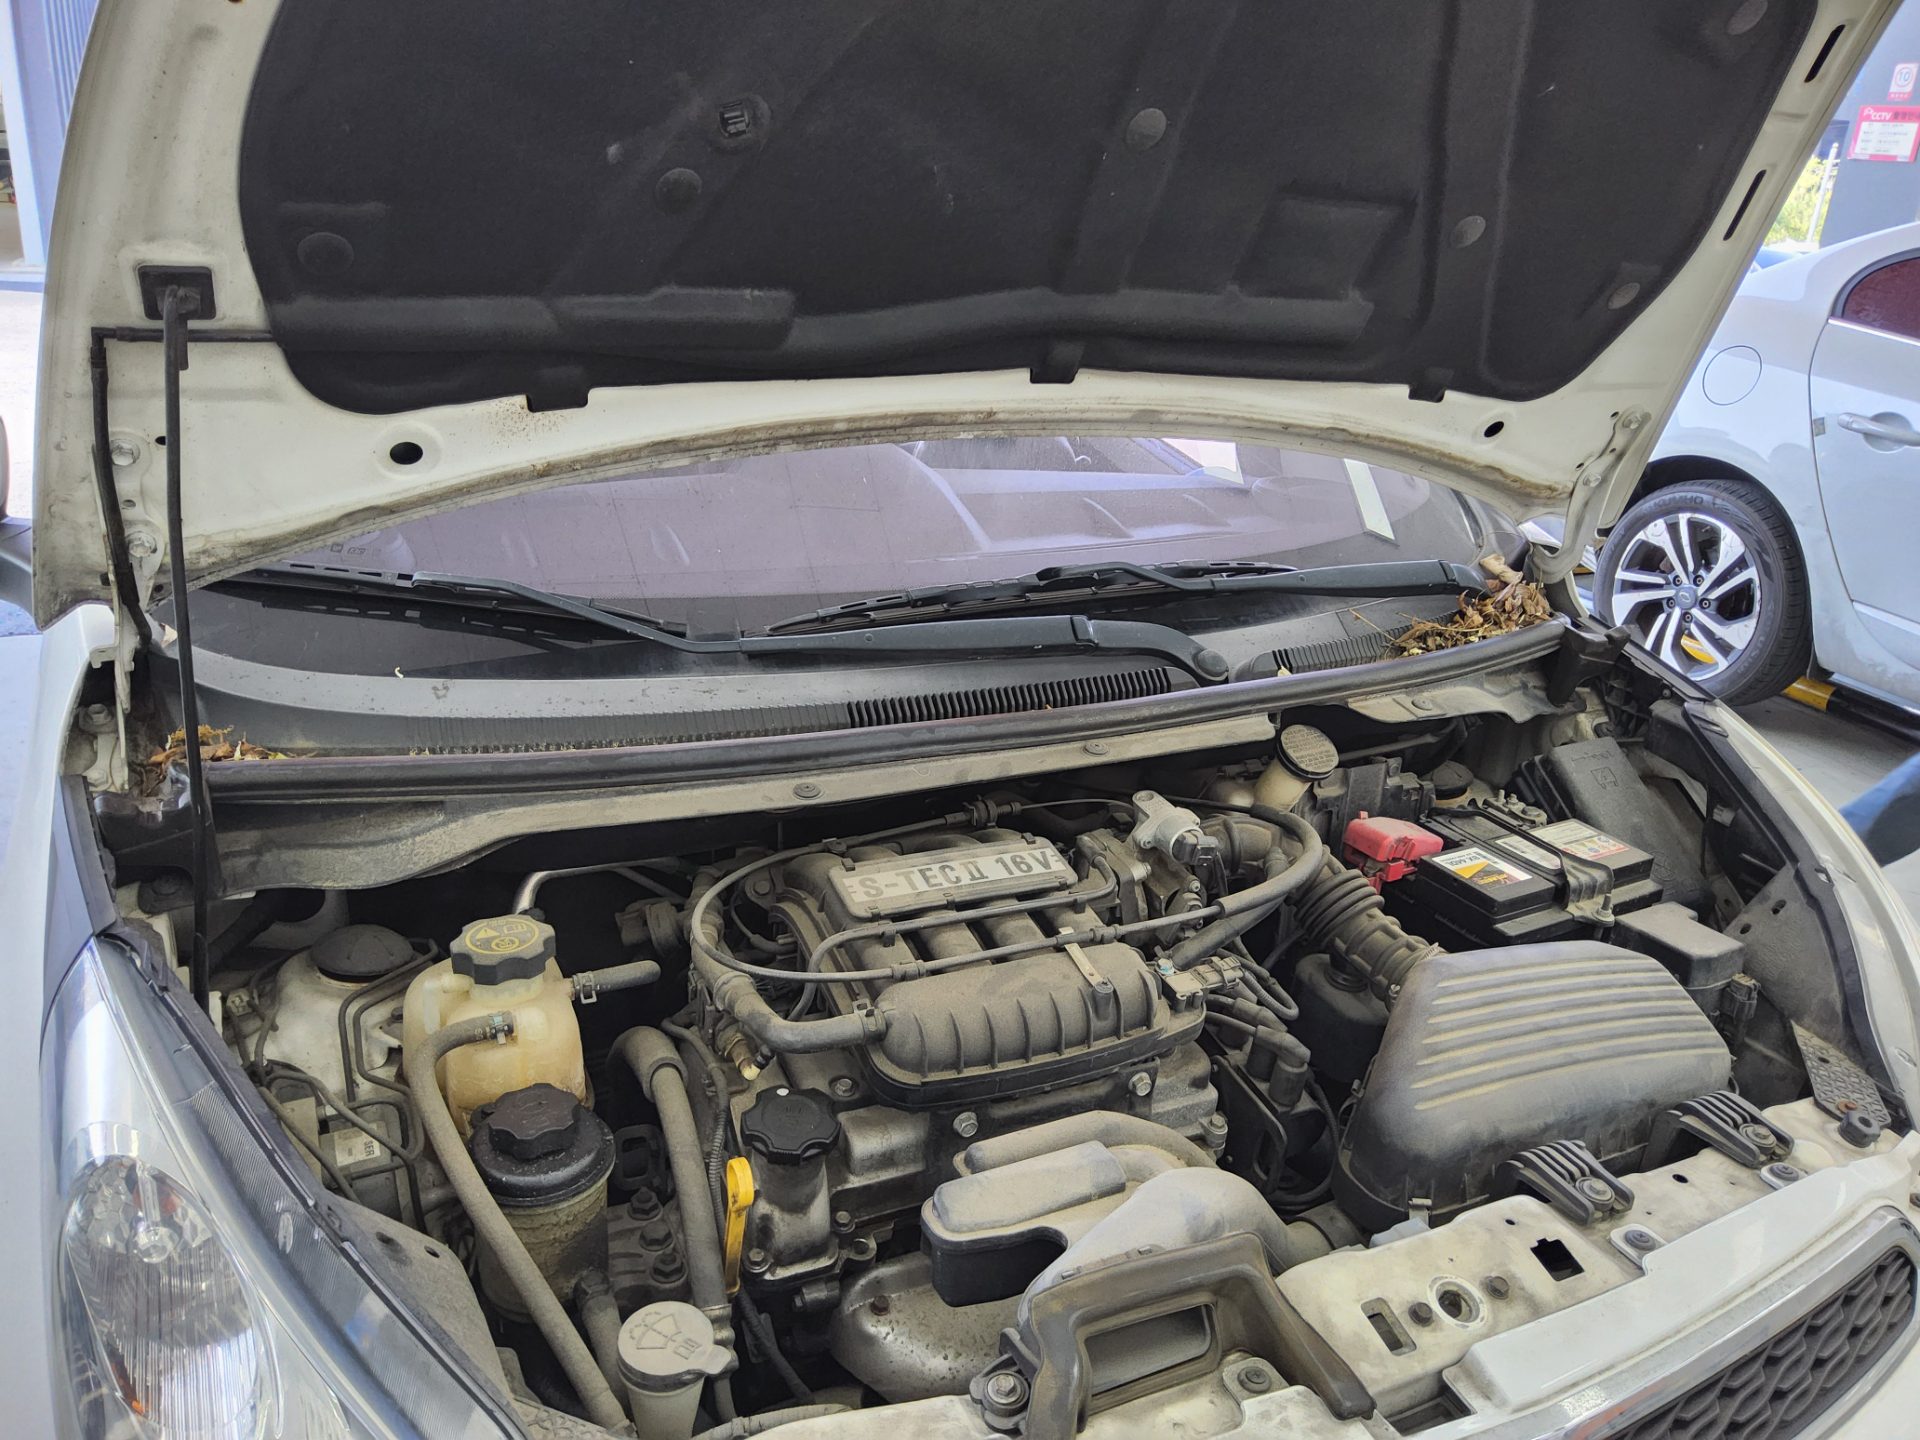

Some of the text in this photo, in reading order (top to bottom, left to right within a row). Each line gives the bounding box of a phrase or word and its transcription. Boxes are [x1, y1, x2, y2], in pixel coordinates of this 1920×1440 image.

[1899, 71, 1910, 82] 10
[1871, 112, 1892, 120] CCTV
[1653, 495, 1704, 507] KUMHO
[995, 850, 1053, 876] 16V
